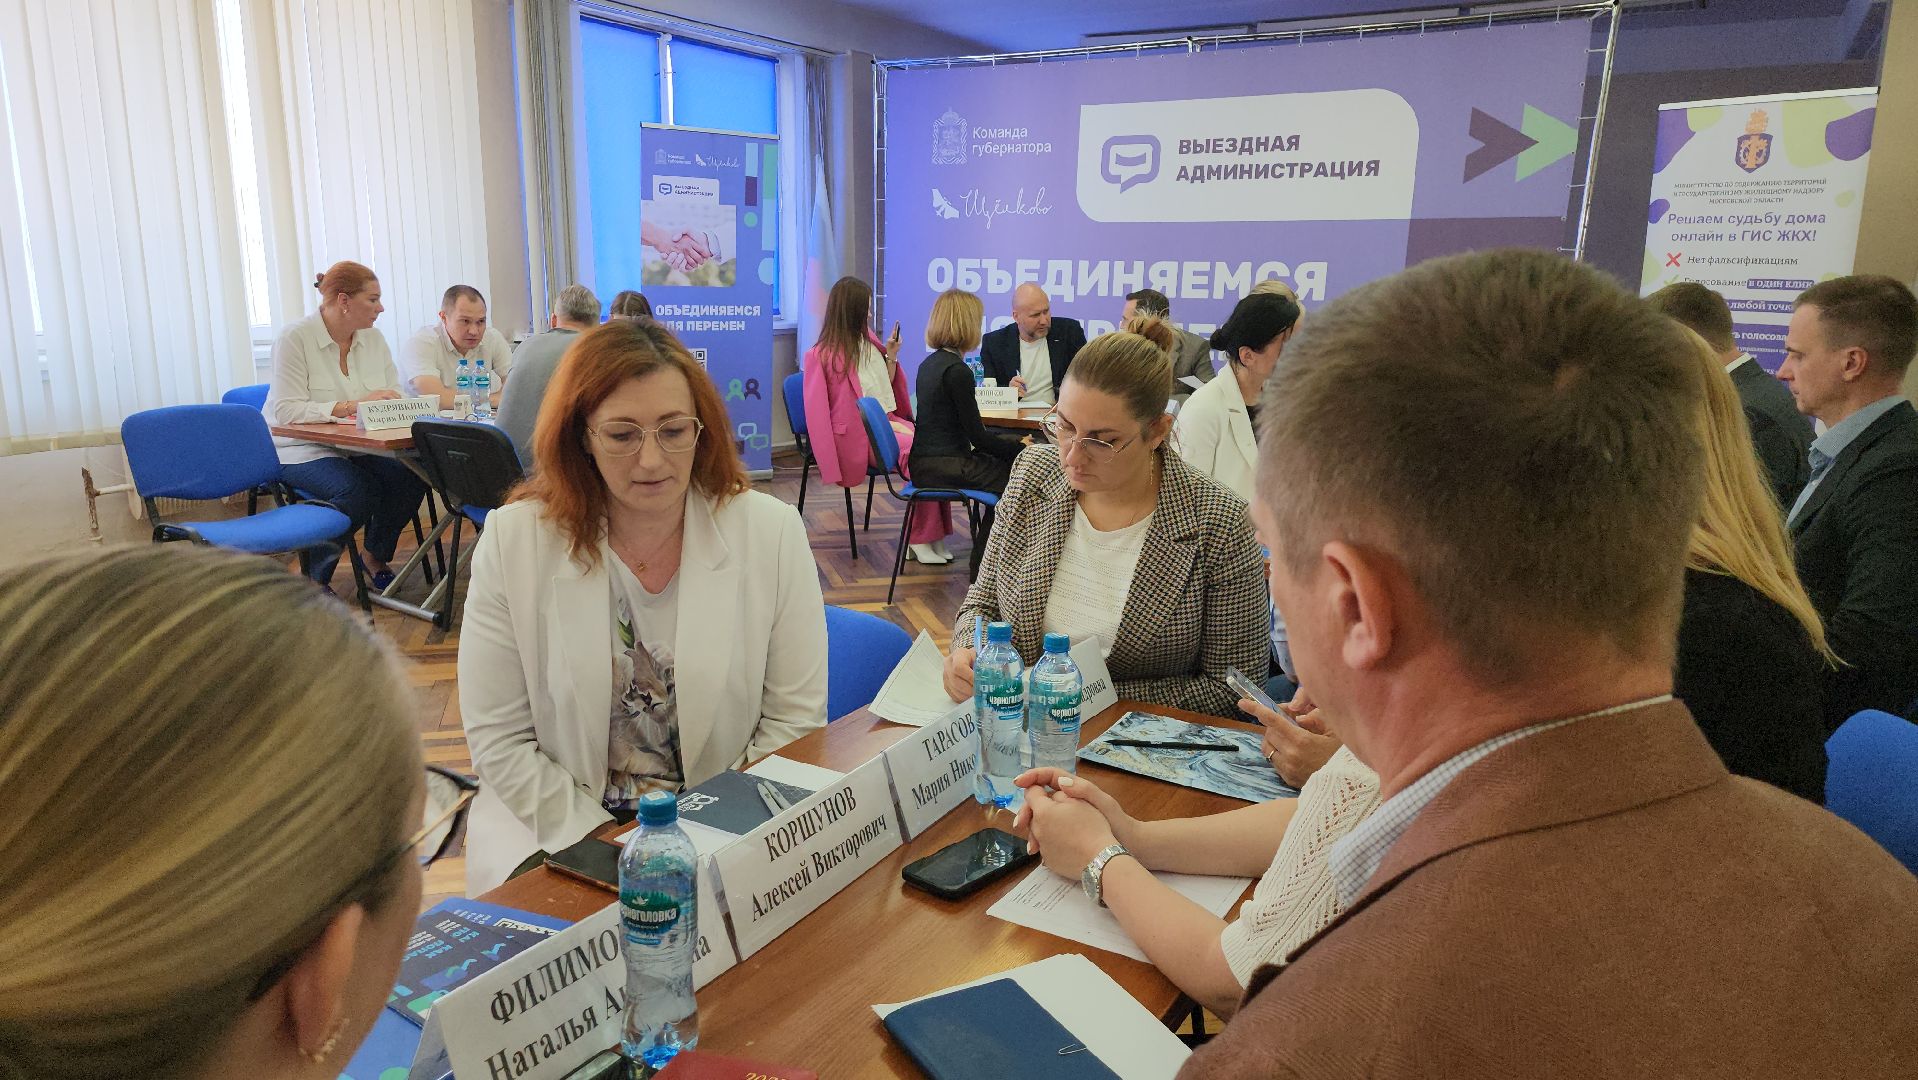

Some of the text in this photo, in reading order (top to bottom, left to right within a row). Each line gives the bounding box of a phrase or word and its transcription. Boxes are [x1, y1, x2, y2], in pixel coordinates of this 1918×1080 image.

[973, 127, 1028, 140] Команда
[972, 142, 1052, 157] губернатора
[1178, 134, 1300, 155] ВЫЕЗДНАЯ
[1176, 159, 1380, 184] АДМИНИСТРАЦИЯ
[1668, 212, 1826, 226] Решаем судьбу дома
[1671, 229, 1817, 242] онлайн в ГИС ЖКХ!
[1687, 256, 1799, 266] Нет фальсификациям
[927, 257, 1328, 302] ОБЪЕДИНЯЕМСЯ
[655, 304, 761, 317] ОБЪЕДИНЯЕМСЯ
[1730, 300, 1765, 310] любой
[686, 321, 745, 332] ПЕРЕМЕН
[922, 713, 976, 761] ТАРАСОВ
[911, 753, 977, 810] Мария Нико
[763, 786, 857, 864] КОРШУНОВ
[752, 813, 888, 923] Алексей Викторович
[491, 926, 620, 1024] ФИЛИМО
[484, 1005, 599, 1080] Наталья
